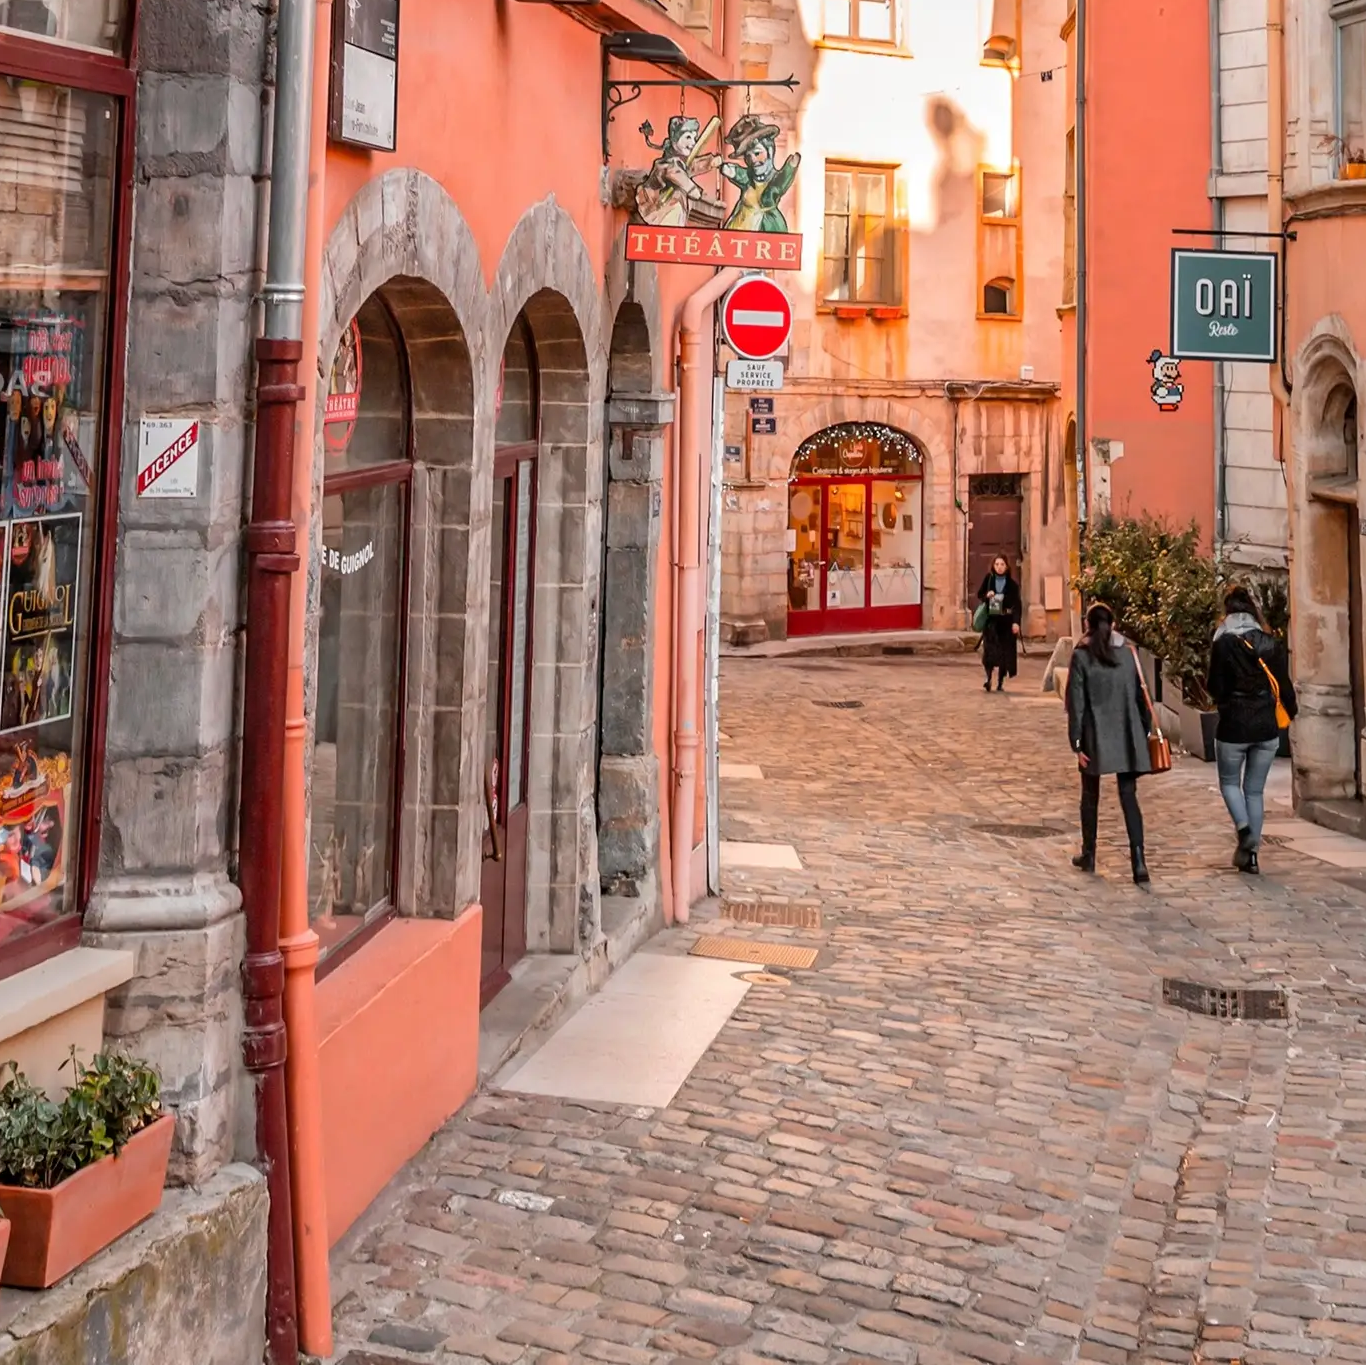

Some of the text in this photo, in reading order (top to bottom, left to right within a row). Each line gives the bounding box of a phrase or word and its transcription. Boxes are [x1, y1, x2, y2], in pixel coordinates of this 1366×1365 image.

[631, 232, 798, 263] THÉÂTRE
[1195, 274, 1253, 319] OAÏ
[736, 379, 775, 387] PROPRETÉ
[747, 363, 766, 371] SAUF
[143, 429, 193, 487] LICENCE
[329, 548, 340, 570] DE
[341, 541, 374, 575] GUIGNOL
